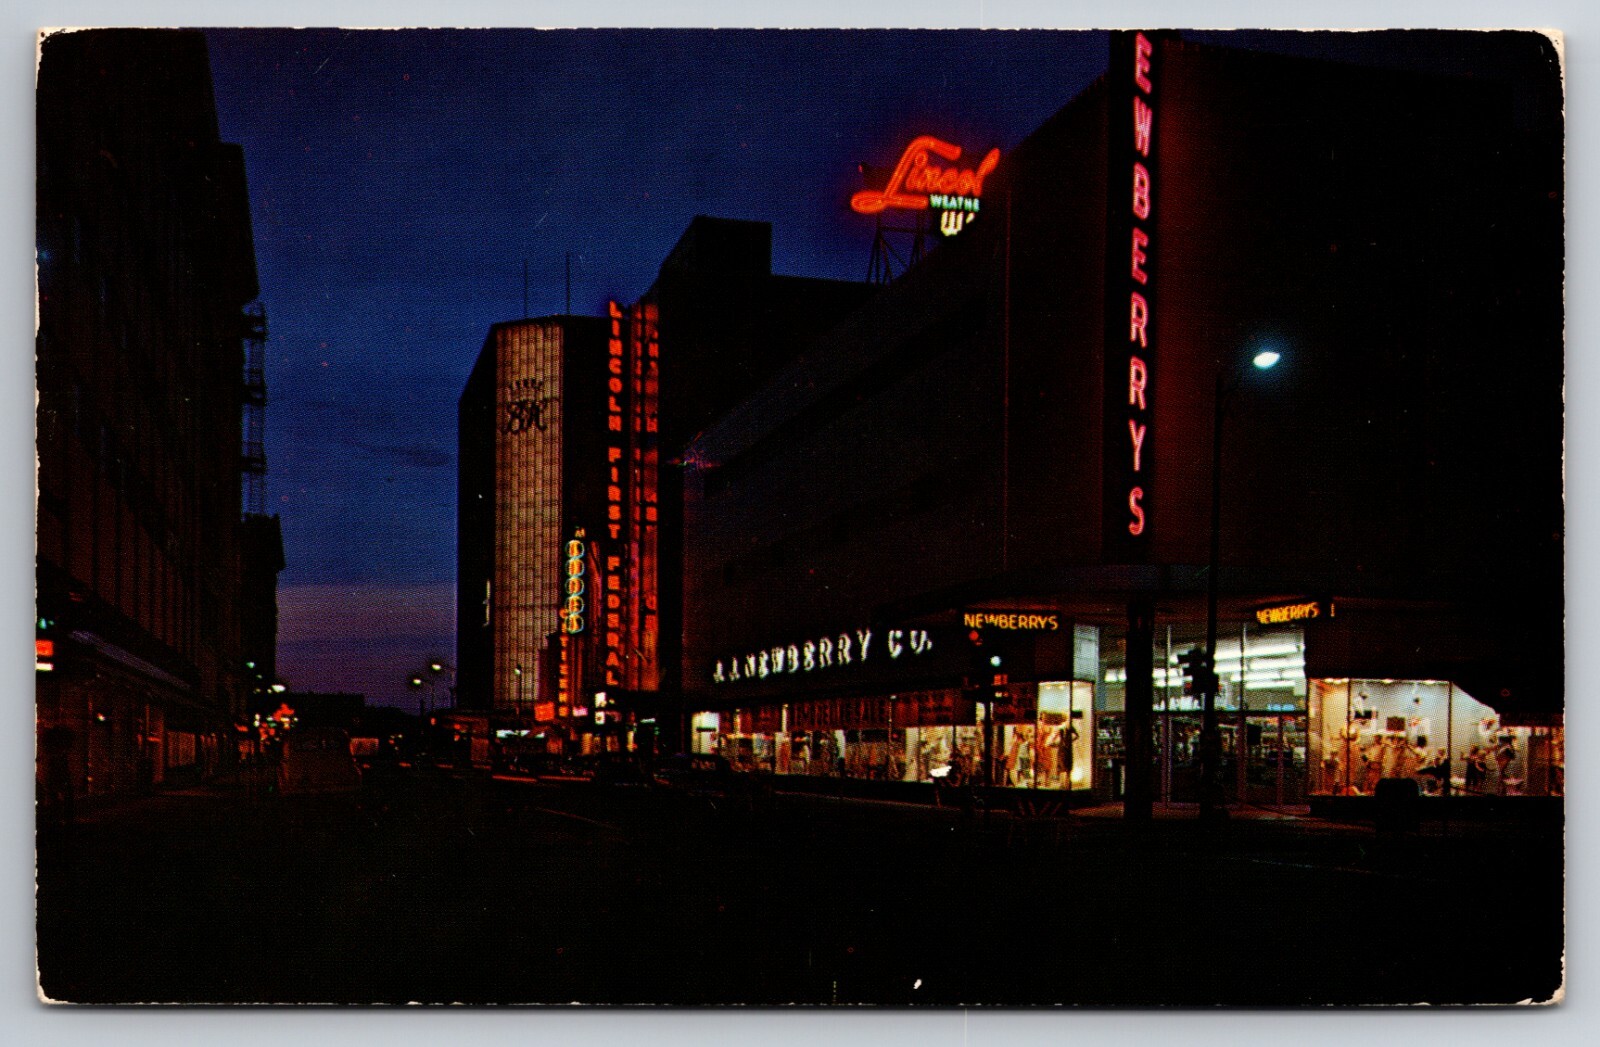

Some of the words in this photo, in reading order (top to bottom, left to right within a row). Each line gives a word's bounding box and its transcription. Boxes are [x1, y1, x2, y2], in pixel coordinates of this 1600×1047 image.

[607, 300, 623, 432] LINCOLN
[607, 446, 622, 540] FIRST
[605, 555, 621, 686] FEDERAL
[964, 613, 1059, 631] NEWBERRYS
